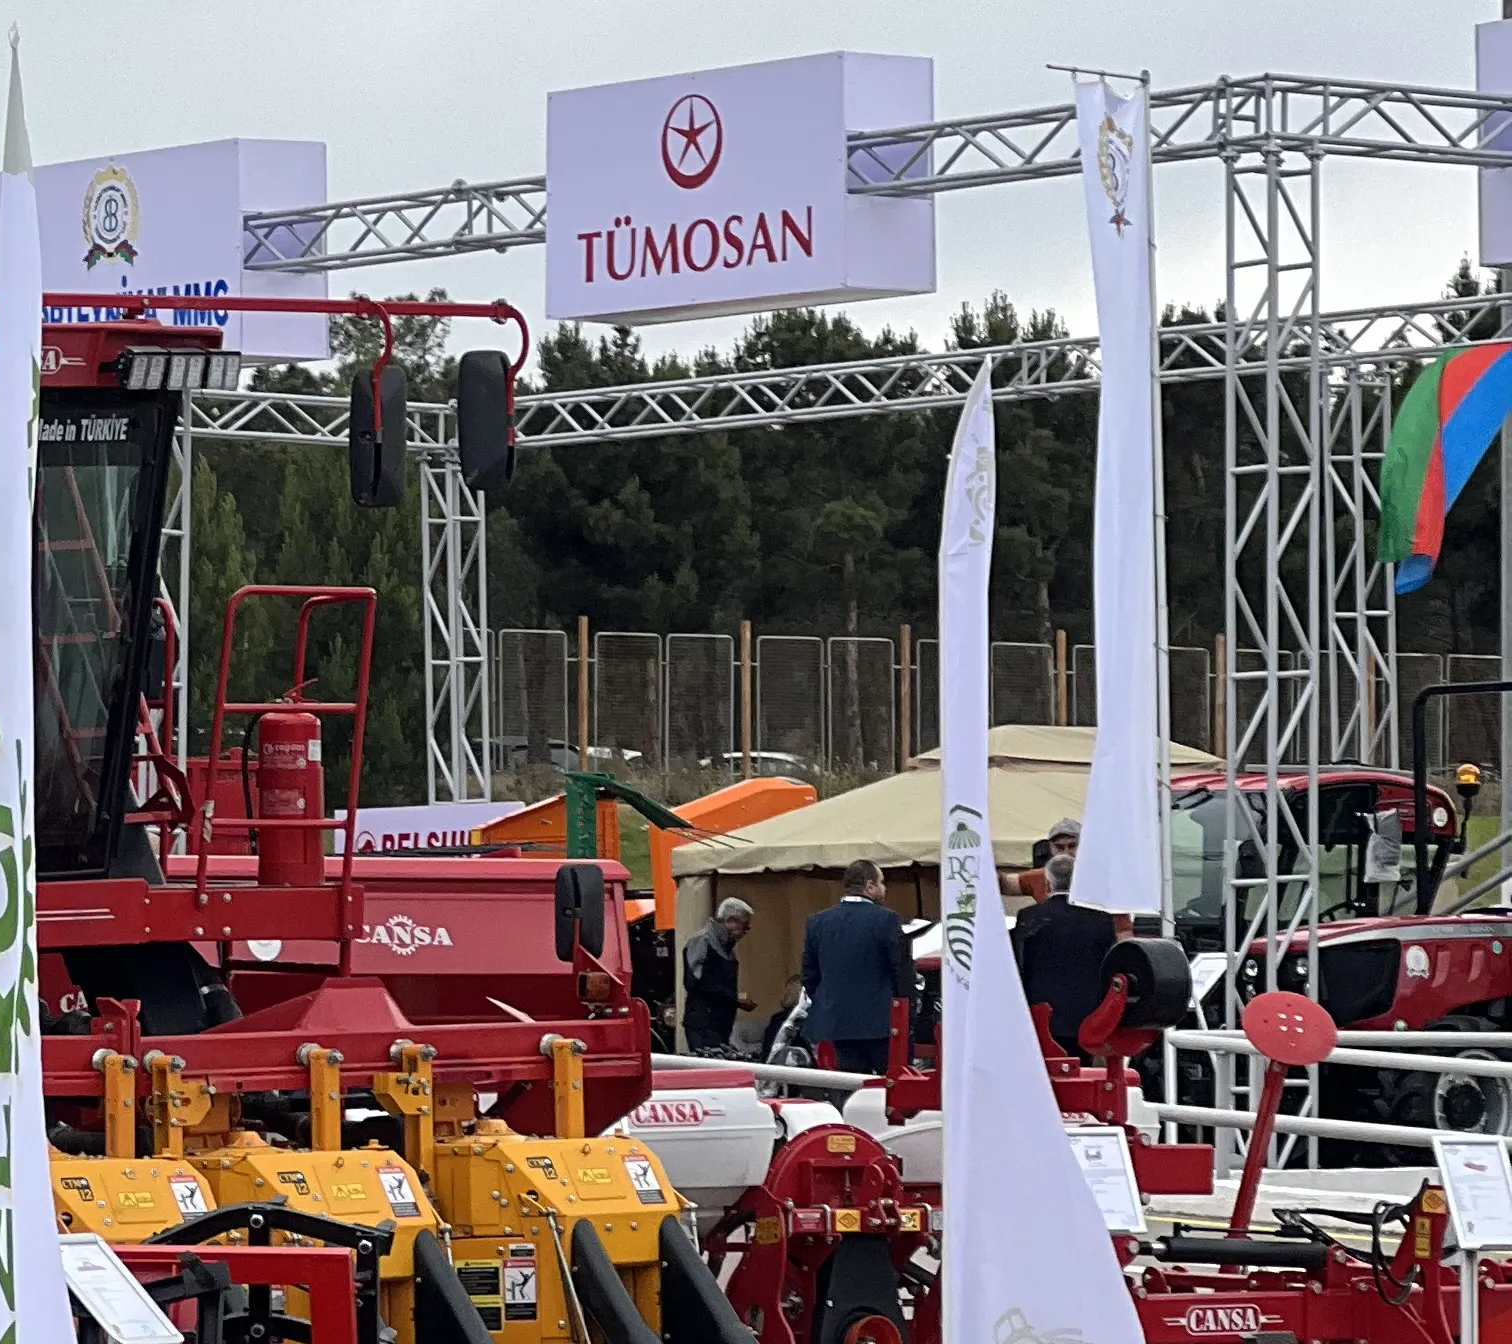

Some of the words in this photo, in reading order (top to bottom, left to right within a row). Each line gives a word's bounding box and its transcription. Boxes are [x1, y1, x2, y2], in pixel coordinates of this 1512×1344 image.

[576, 205, 813, 284] TÜMOSAN
[38, 418, 64, 442] ade
[80, 413, 129, 442] TÜRKİYE
[634, 1103, 700, 1124] CANSA
[1190, 1308, 1258, 1332] CANSA
